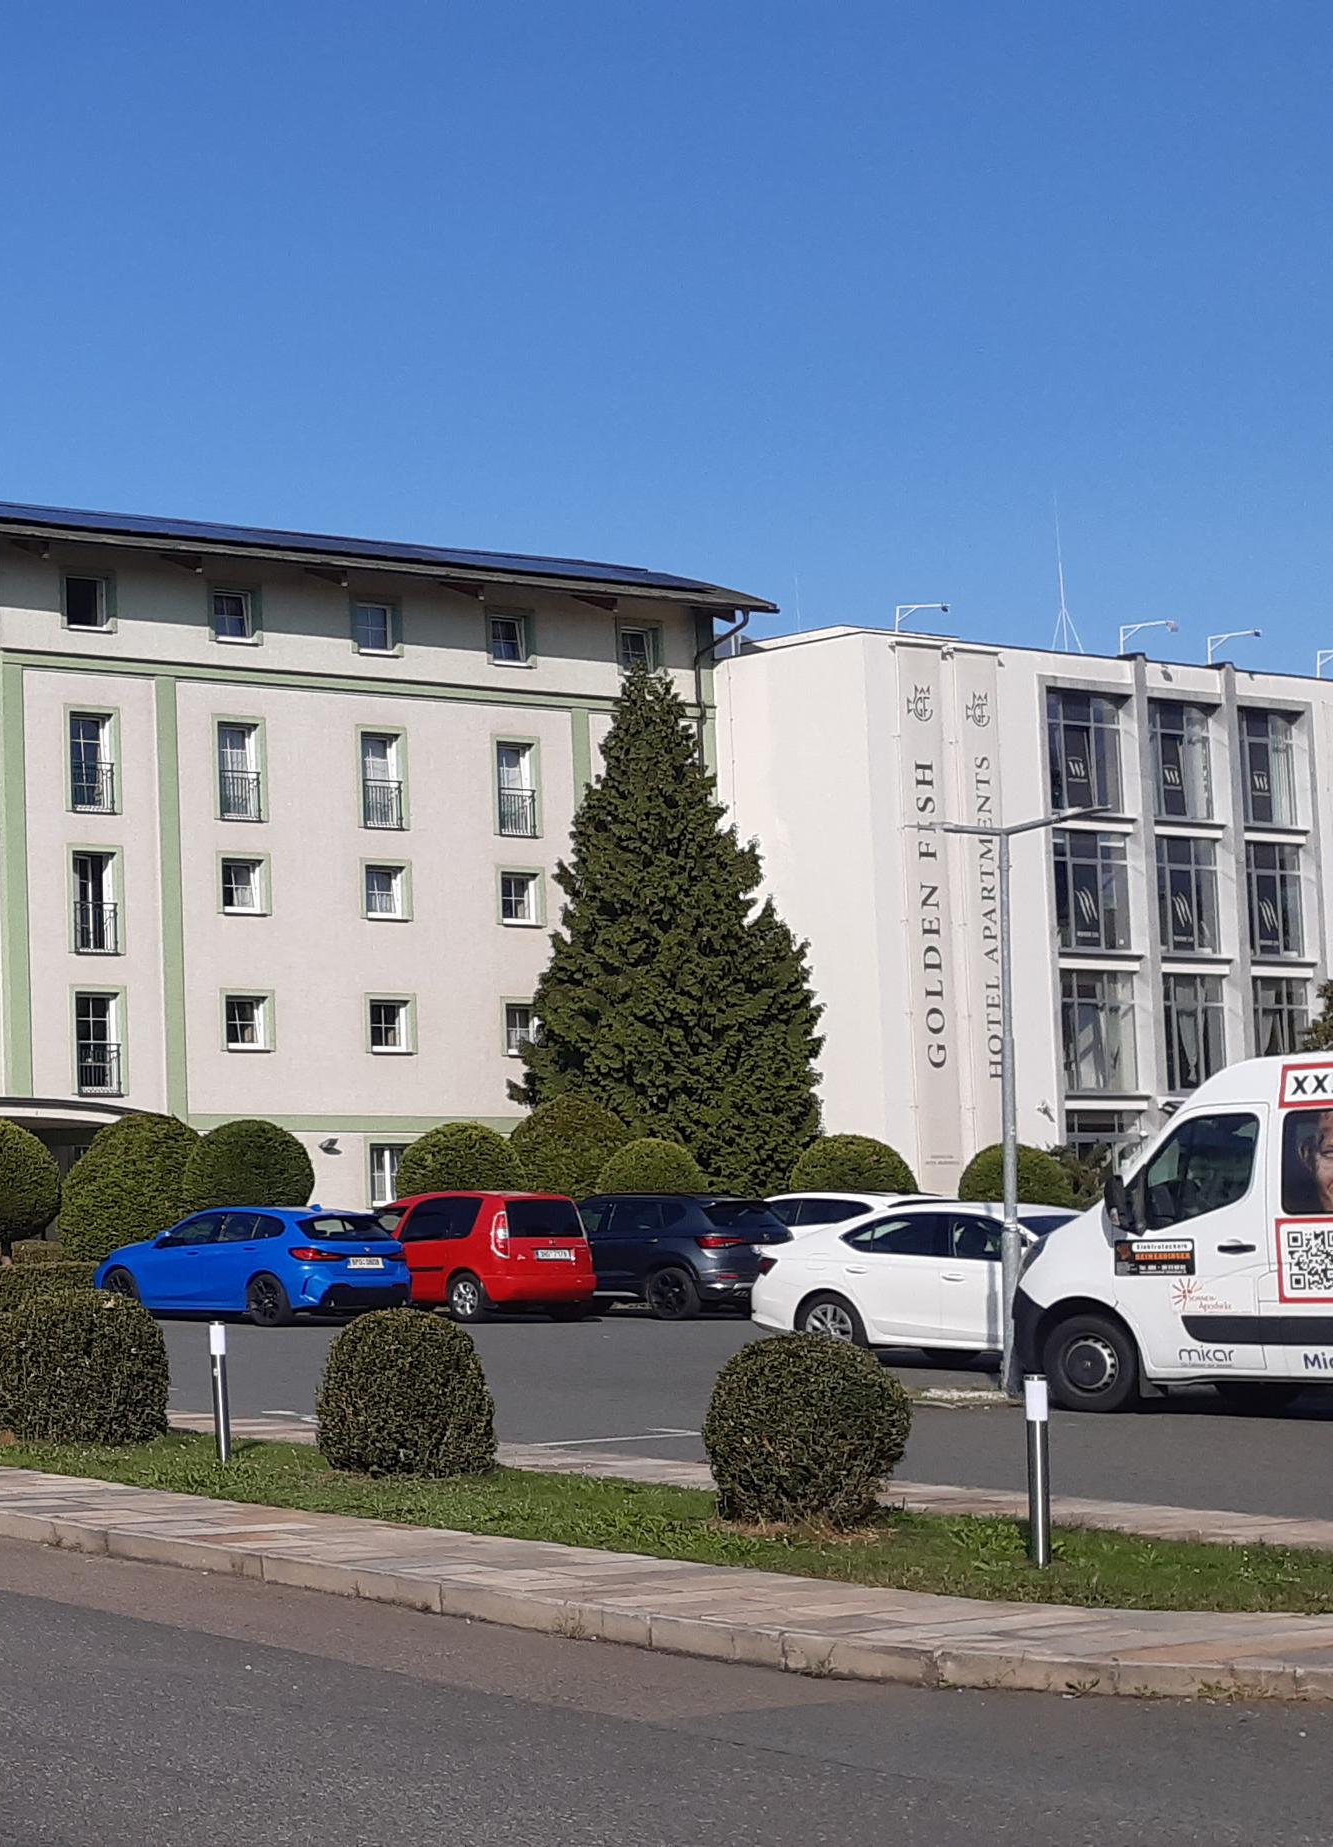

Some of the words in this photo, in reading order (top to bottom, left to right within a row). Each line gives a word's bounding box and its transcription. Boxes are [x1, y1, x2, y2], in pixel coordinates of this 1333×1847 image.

[915, 760, 938, 861] FISH
[974, 756, 998, 965] APARTMENTS
[920, 882, 947, 1069] GOLDEN
[985, 975, 1003, 1079] HOTEL
[1290, 1073, 1333, 1096] XX
[1178, 1345, 1235, 1362] mikar
